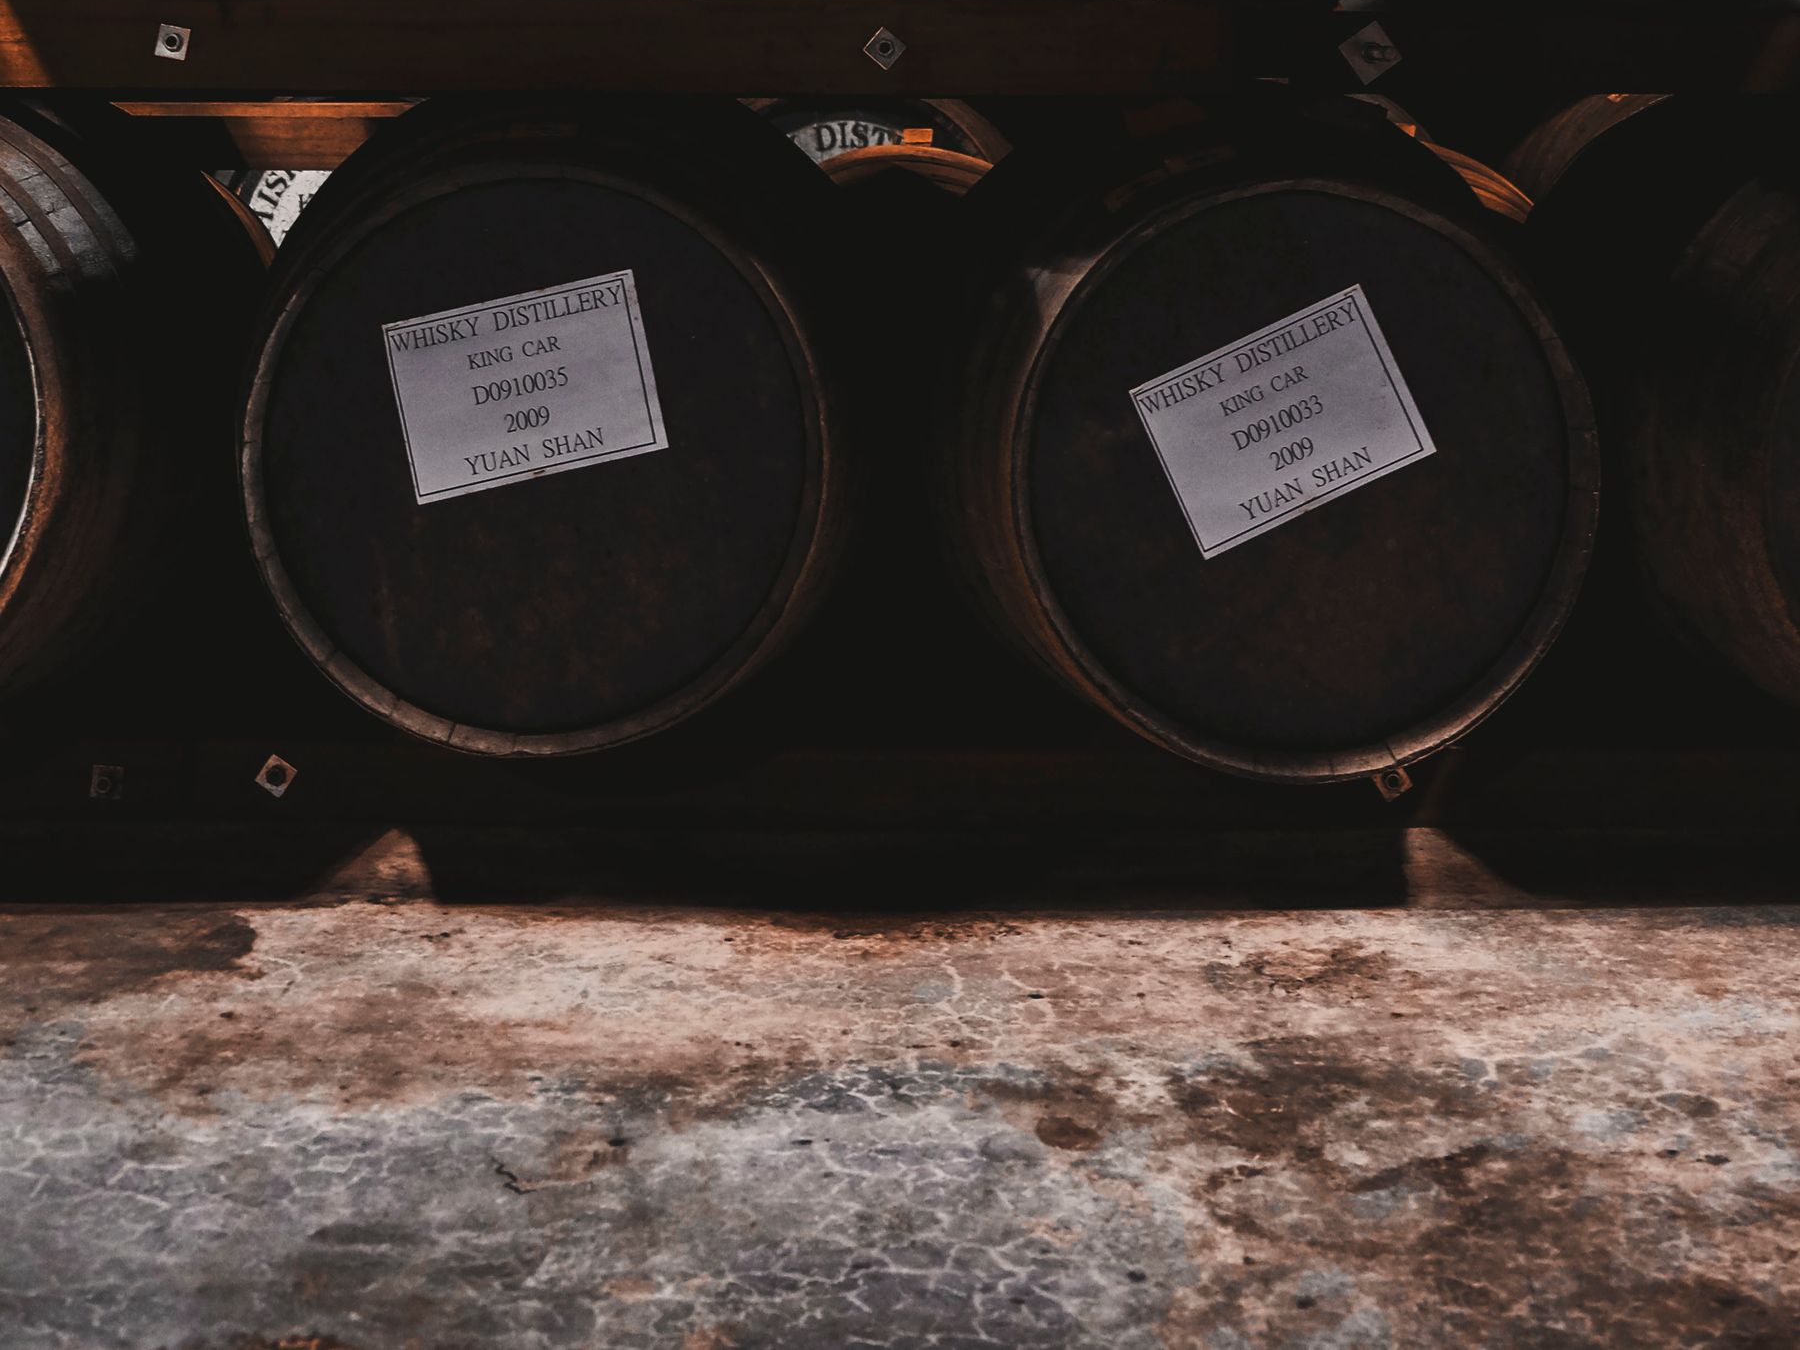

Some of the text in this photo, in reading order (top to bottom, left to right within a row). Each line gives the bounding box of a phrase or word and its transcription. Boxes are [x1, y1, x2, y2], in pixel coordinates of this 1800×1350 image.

[390, 284, 622, 353] WHISKY DISTILLERY
[466, 335, 561, 370] KING CAR
[1139, 302, 1357, 415] WHISKY DISTILLERY
[472, 366, 568, 405] D0910035
[1219, 365, 1309, 417] KING CAR
[504, 406, 551, 433] 2009
[1230, 394, 1324, 451] D0910033
[464, 427, 605, 476] YUAN SHAN
[1268, 437, 1314, 472] 2009
[1239, 446, 1373, 520] YUAN SHAN
